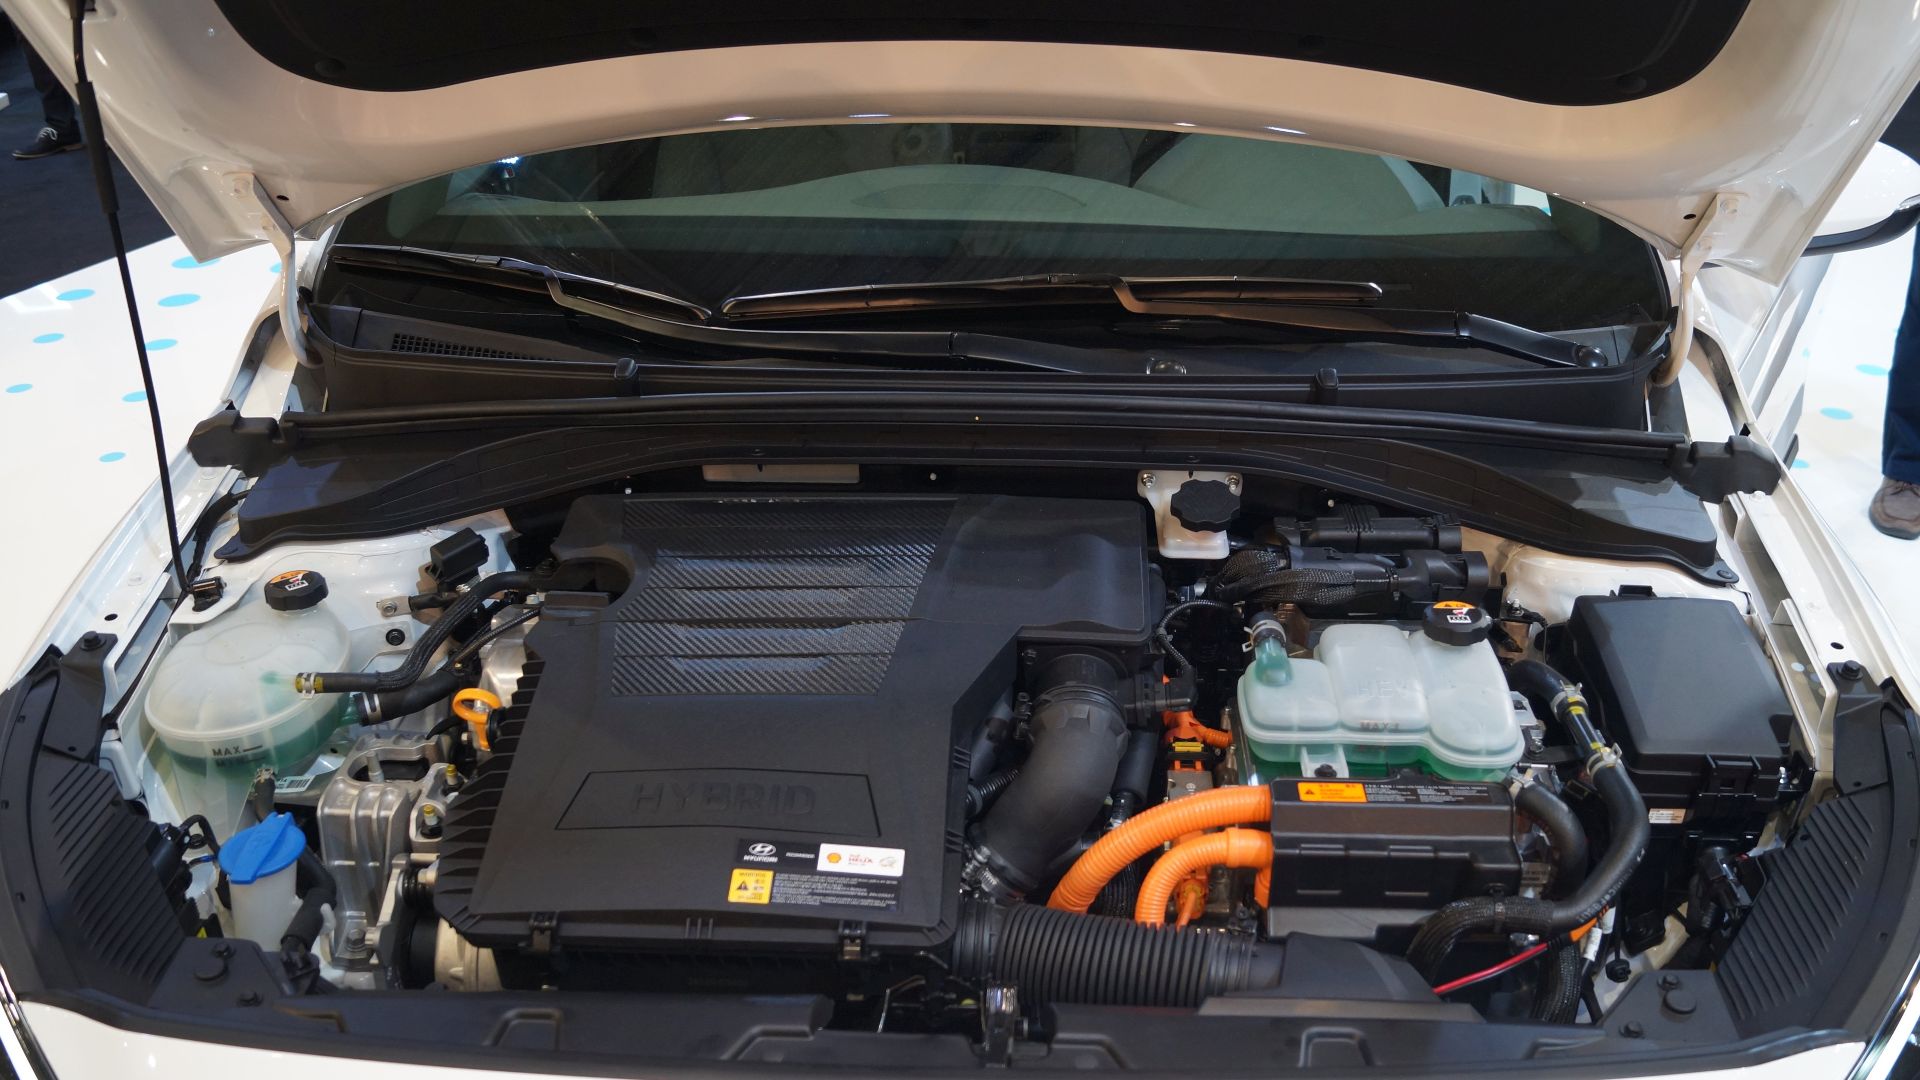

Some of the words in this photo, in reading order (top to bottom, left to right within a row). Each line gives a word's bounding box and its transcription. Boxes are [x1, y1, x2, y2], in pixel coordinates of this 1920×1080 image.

[212, 746, 241, 757] MAX
[632, 782, 816, 816] HYBRID
[743, 854, 778, 863] HYUNDAI
